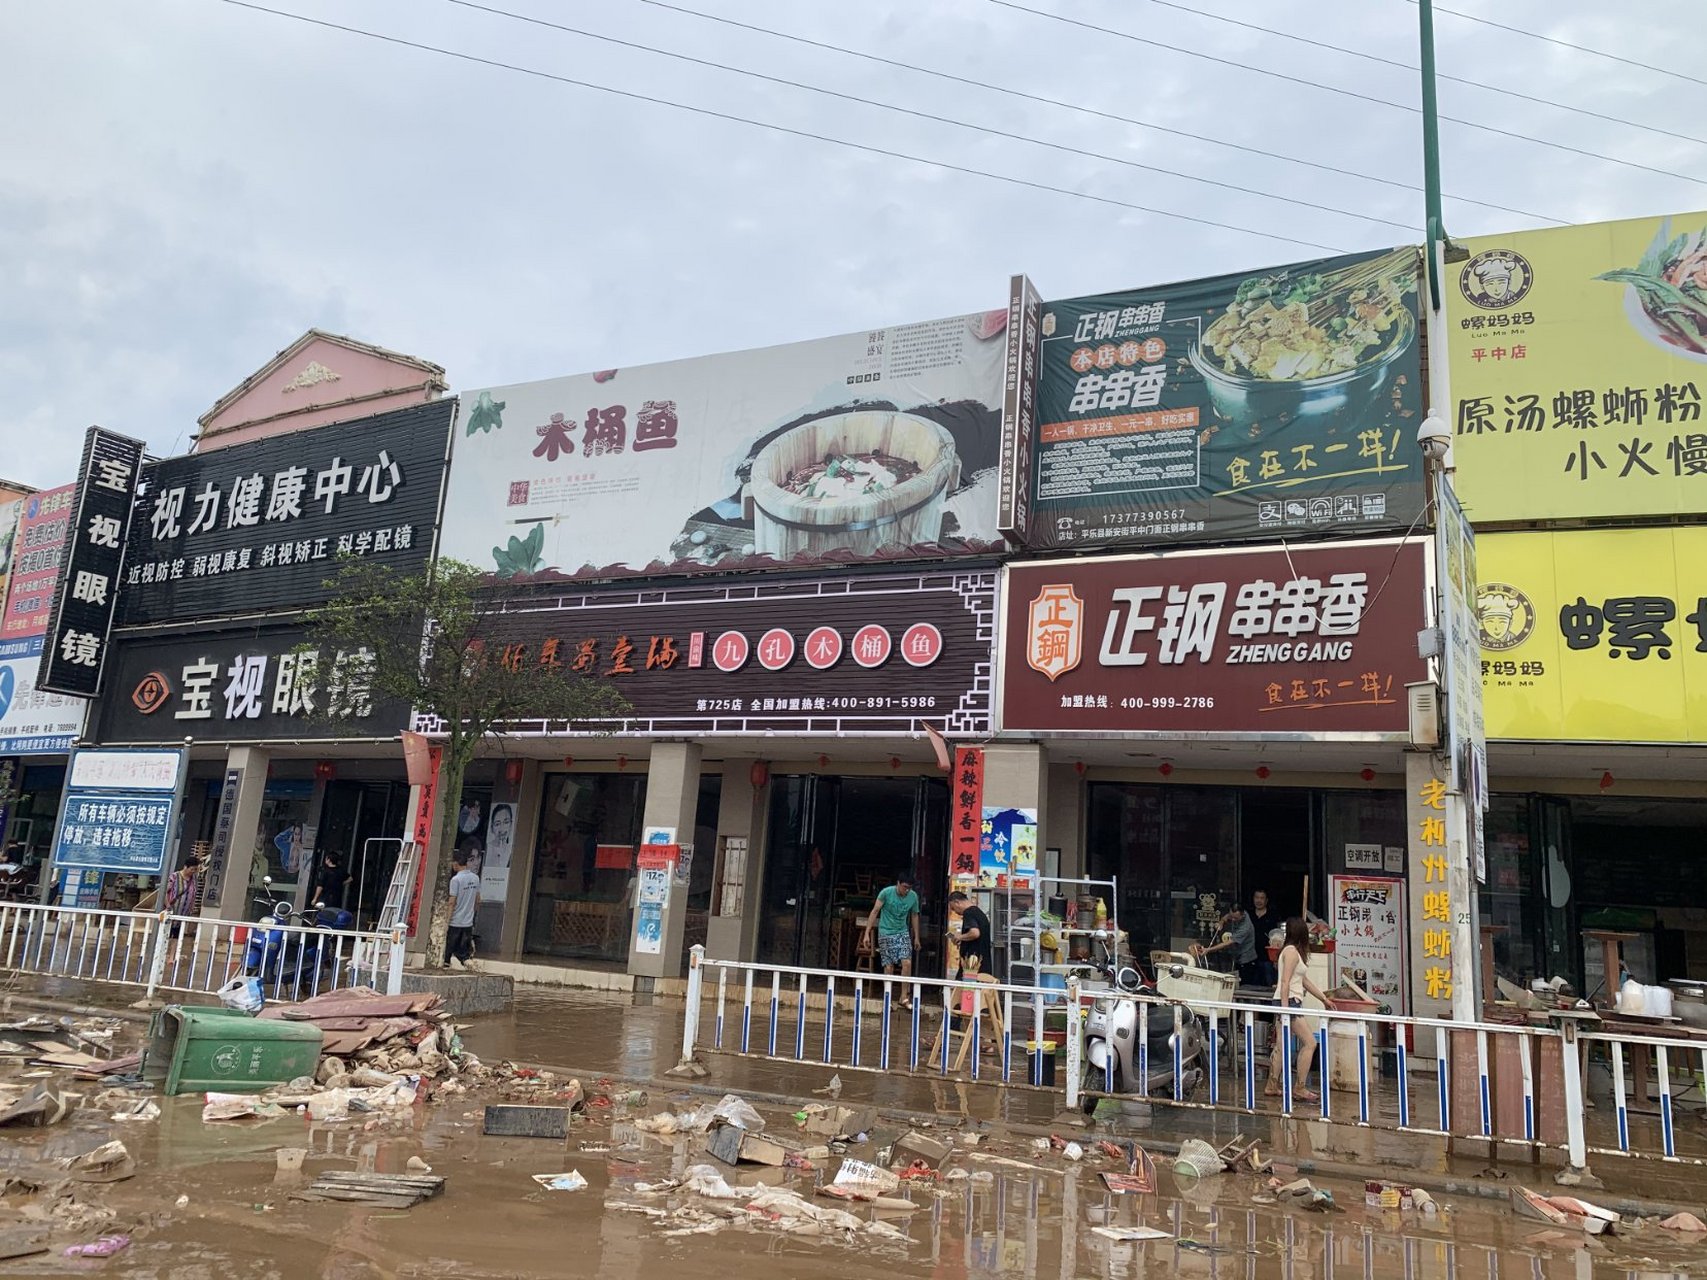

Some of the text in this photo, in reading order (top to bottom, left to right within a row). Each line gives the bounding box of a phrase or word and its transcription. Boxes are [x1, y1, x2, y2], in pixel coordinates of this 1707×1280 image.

[1114, 325, 1160, 338] ZHENGGANG
[1461, 311, 1535, 330] 螺妈妈
[1074, 339, 1164, 370] 本店特色
[1471, 344, 1527, 362] 平中店
[1068, 364, 1167, 414] 串串香
[1457, 381, 1703, 437] 原汤螺蛳粉
[532, 400, 679, 462] 木桶鱼
[150, 449, 402, 542] 视力健康中心
[1103, 509, 1186, 525] 17377390567
[60, 457, 133, 668] 宝视眼镜
[127, 524, 413, 586] 近视防控 弱视康复 斜视矫正 科学配镜
[720, 632, 932, 663] 九孔木桶鱼
[1226, 640, 1353, 664] ZHENGGANG
[174, 645, 377, 720] 宝视眼镜
[696, 698, 743, 711] 第725店
[77, 803, 167, 825] 所有车辆必须按规定
[1347, 850, 1380, 863] 空调开放
